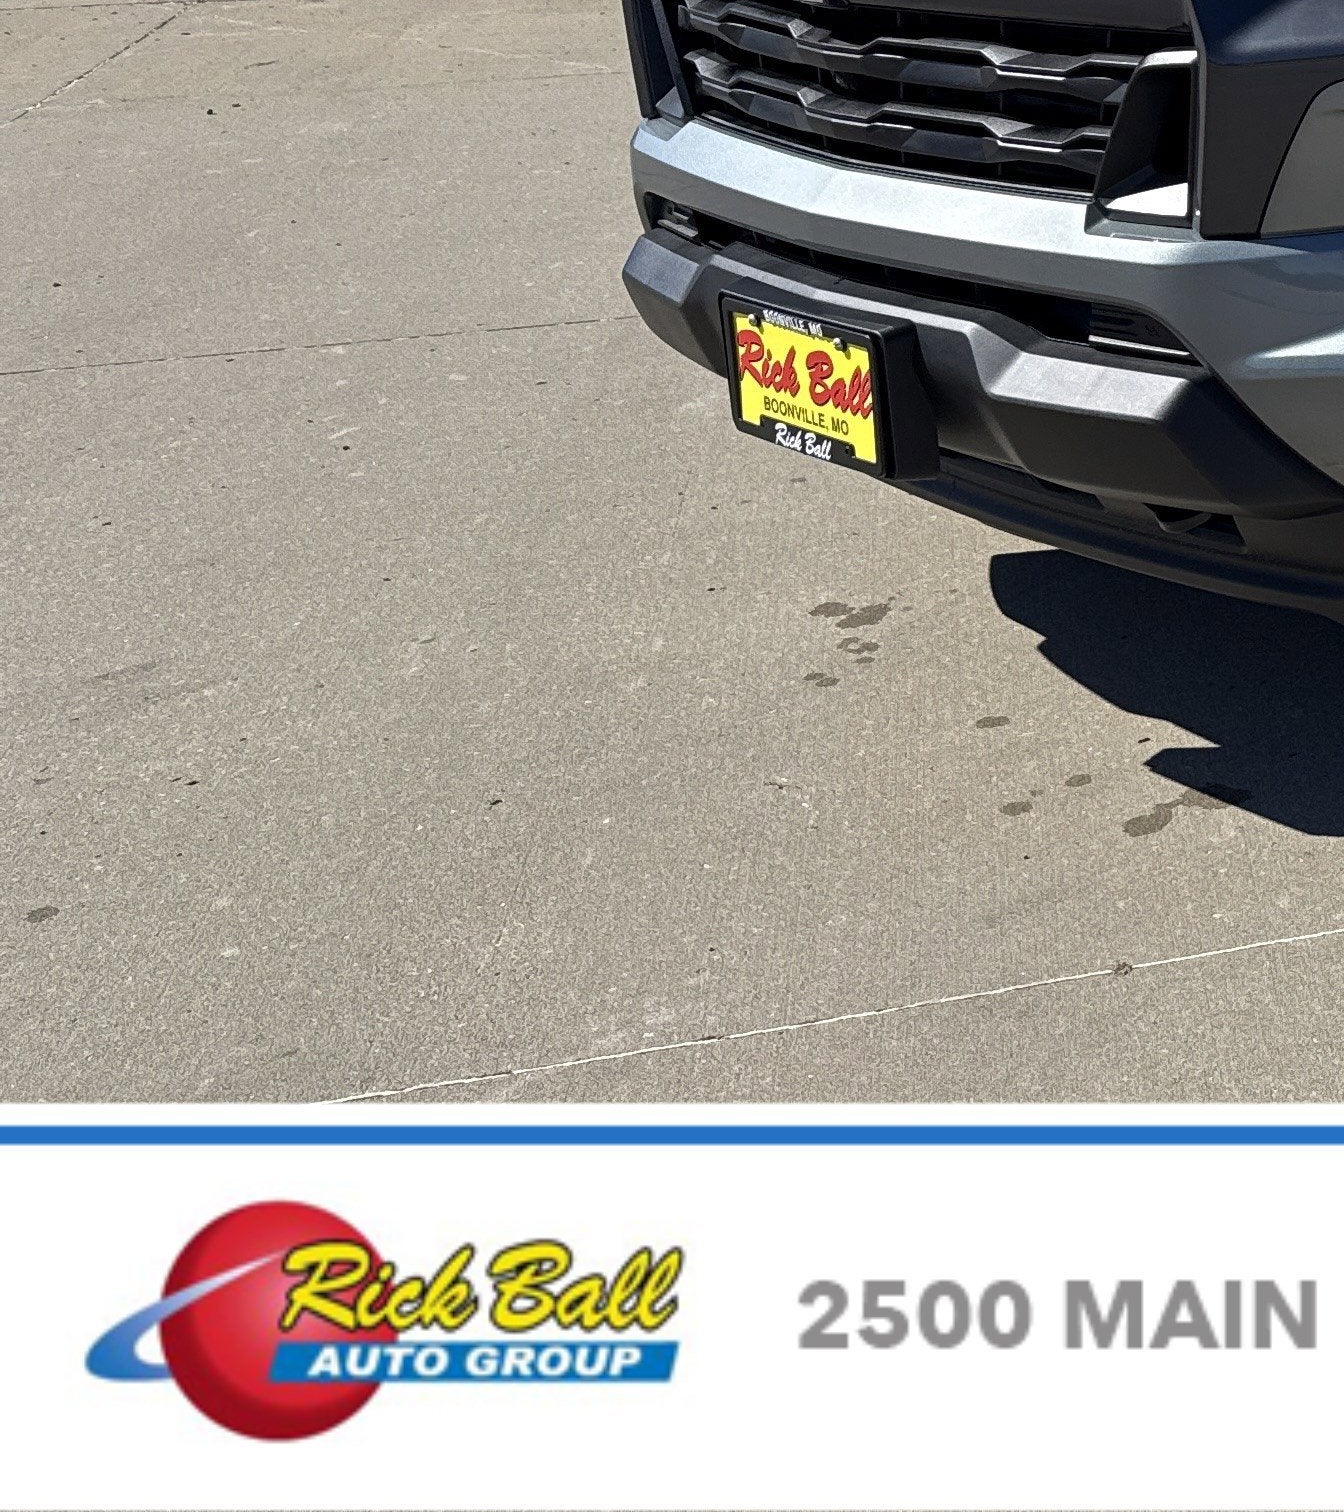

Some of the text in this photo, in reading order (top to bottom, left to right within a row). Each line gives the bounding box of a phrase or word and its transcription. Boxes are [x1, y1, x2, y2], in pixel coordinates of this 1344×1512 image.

[736, 329, 873, 420] Rick Ball
[763, 396, 849, 436] BOONVILLE, MO
[774, 421, 832, 461] Rick Ball
